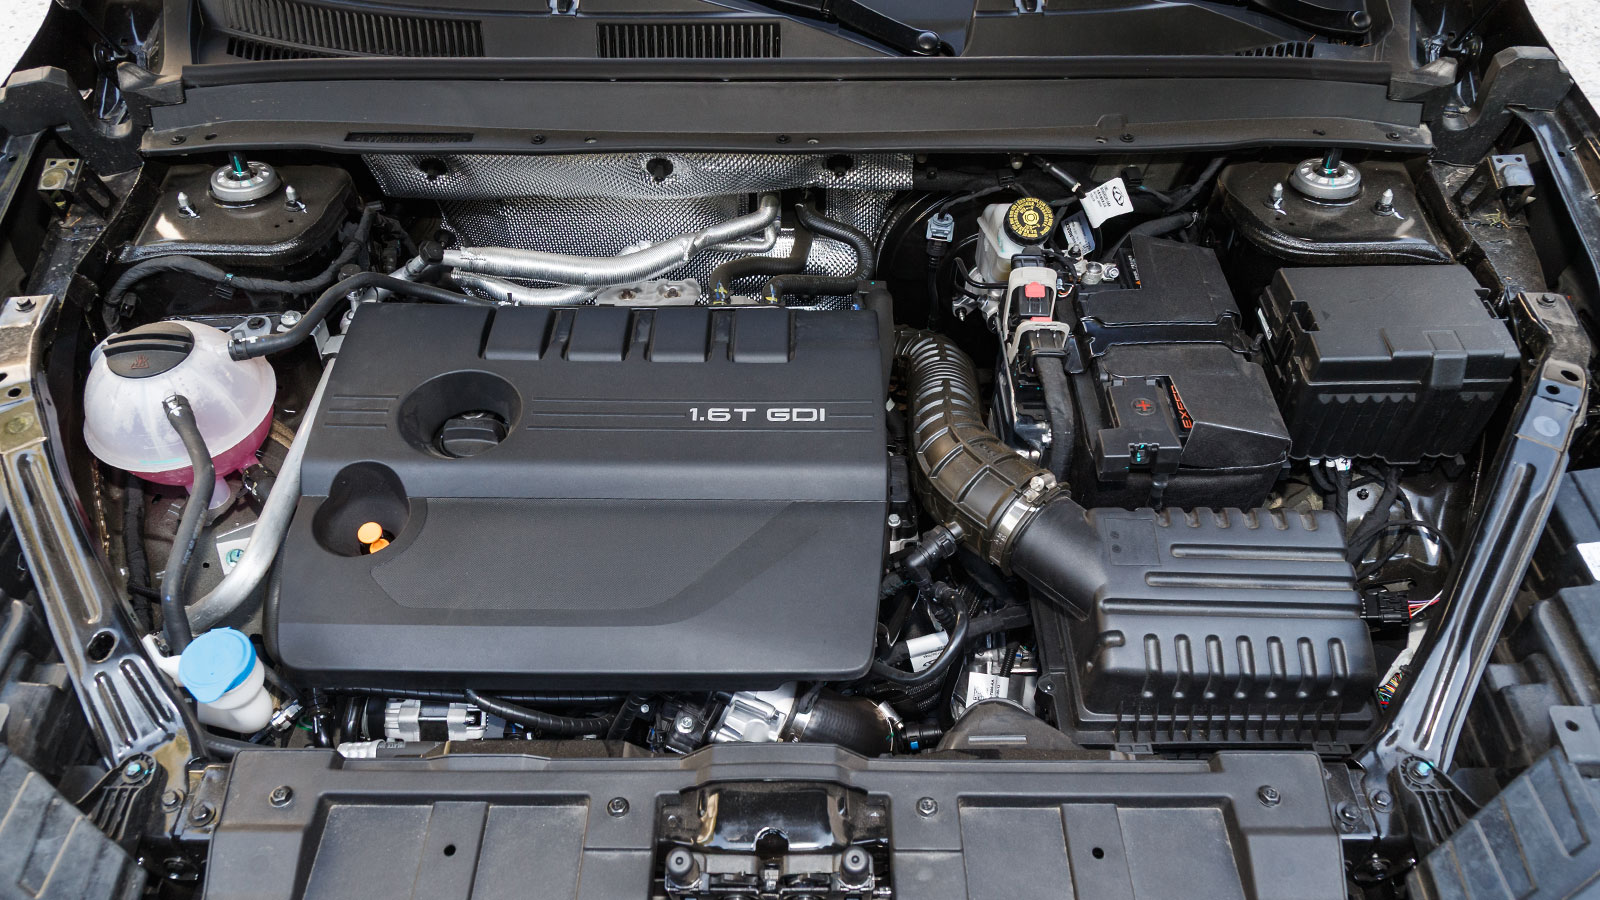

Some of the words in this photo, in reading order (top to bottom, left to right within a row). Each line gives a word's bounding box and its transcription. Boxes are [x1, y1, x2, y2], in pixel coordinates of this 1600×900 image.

[689, 407, 757, 422] 1.6T
[766, 407, 826, 422] GDI
[1171, 385, 1192, 428] EXE
